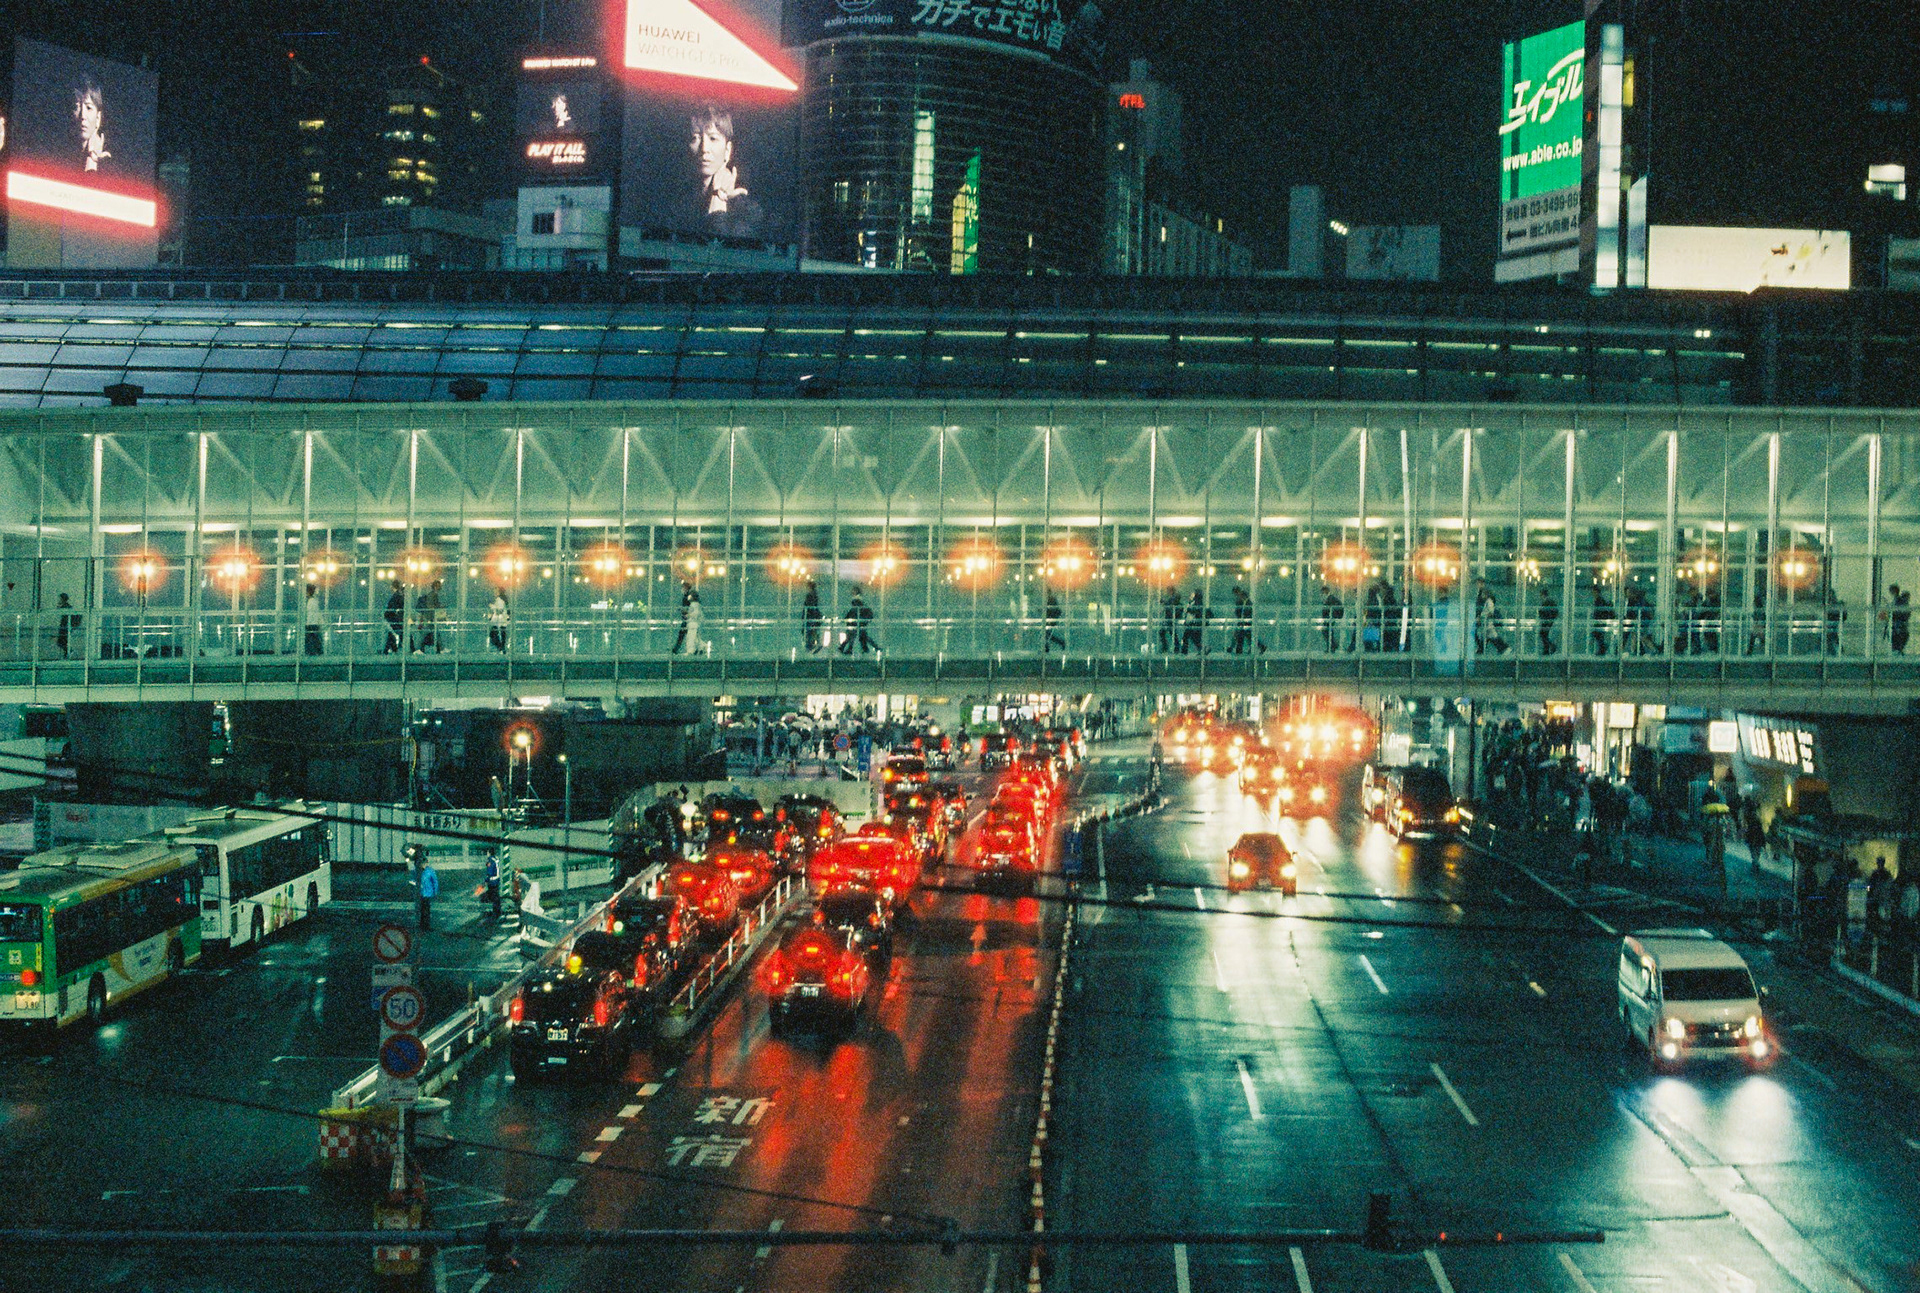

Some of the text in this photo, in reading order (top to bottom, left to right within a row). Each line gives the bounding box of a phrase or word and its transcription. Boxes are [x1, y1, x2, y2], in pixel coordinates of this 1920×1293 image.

[824, 14, 894, 28] audio-technica
[638, 24, 700, 44] HUAWEI
[638, 43, 685, 60] WATCH
[688, 49, 703, 63] GT
[1499, 51, 1584, 134] エイブル
[1503, 136, 1583, 172] www.able.co.jp
[390, 998, 416, 1019] 50
